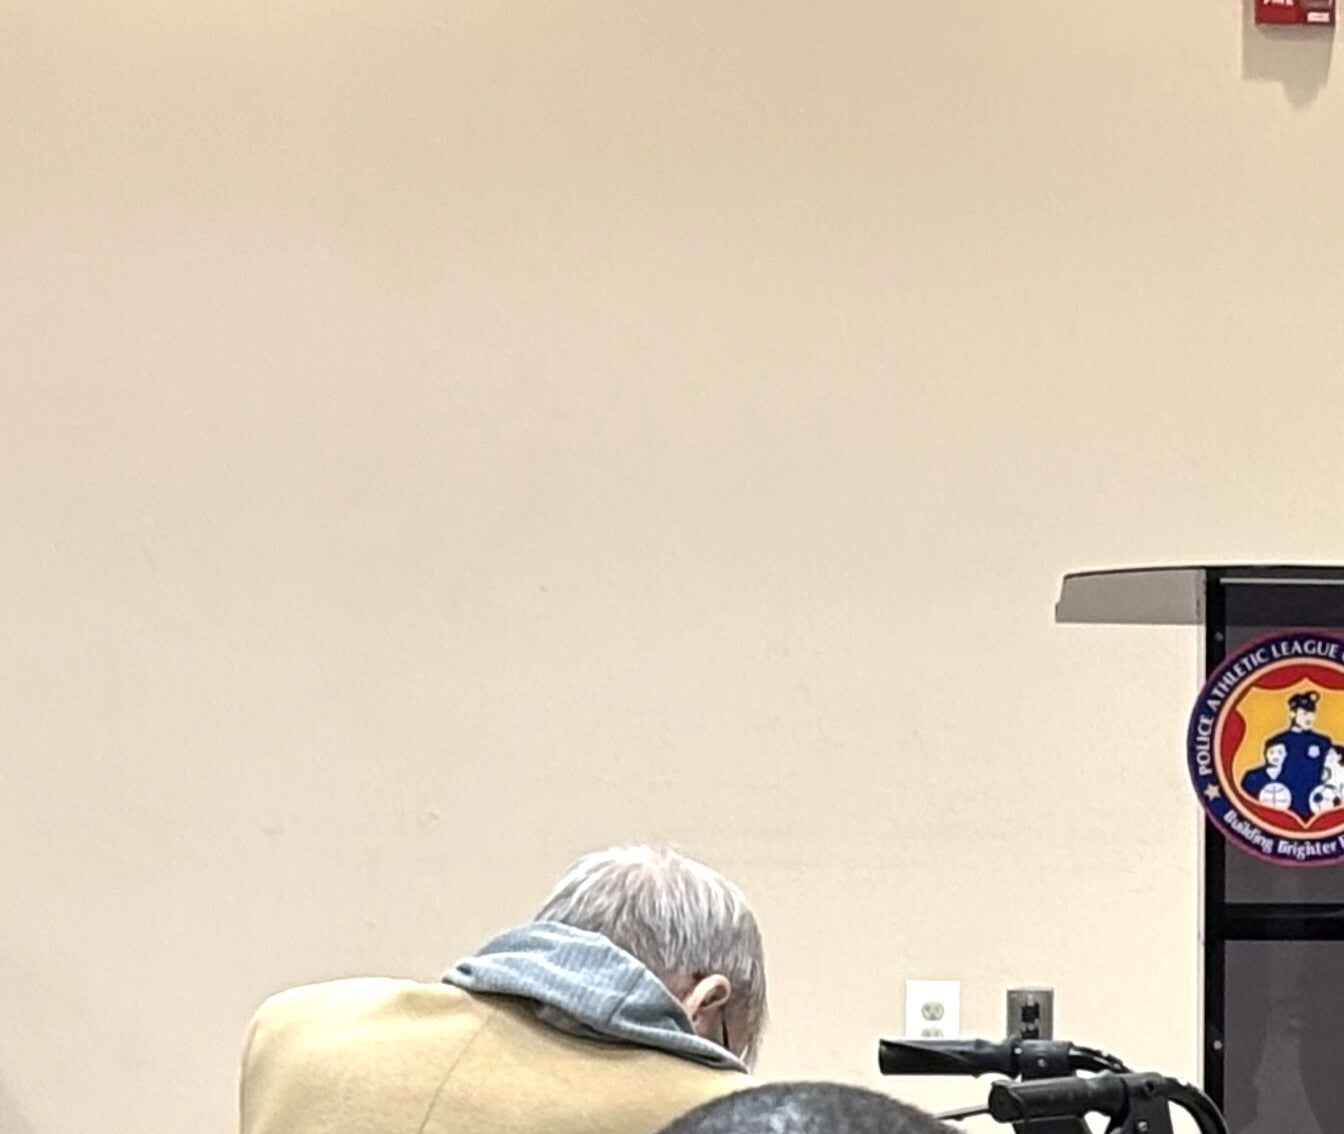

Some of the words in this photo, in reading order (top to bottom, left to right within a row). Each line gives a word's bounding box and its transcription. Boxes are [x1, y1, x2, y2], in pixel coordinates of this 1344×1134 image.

[1196, 715, 1215, 776] POLICE
[1207, 646, 1269, 712] ATHLETIC
[1271, 639, 1340, 658] LEAGUE
[1223, 809, 1274, 854] Building
[1277, 838, 1337, 860] Brighter
